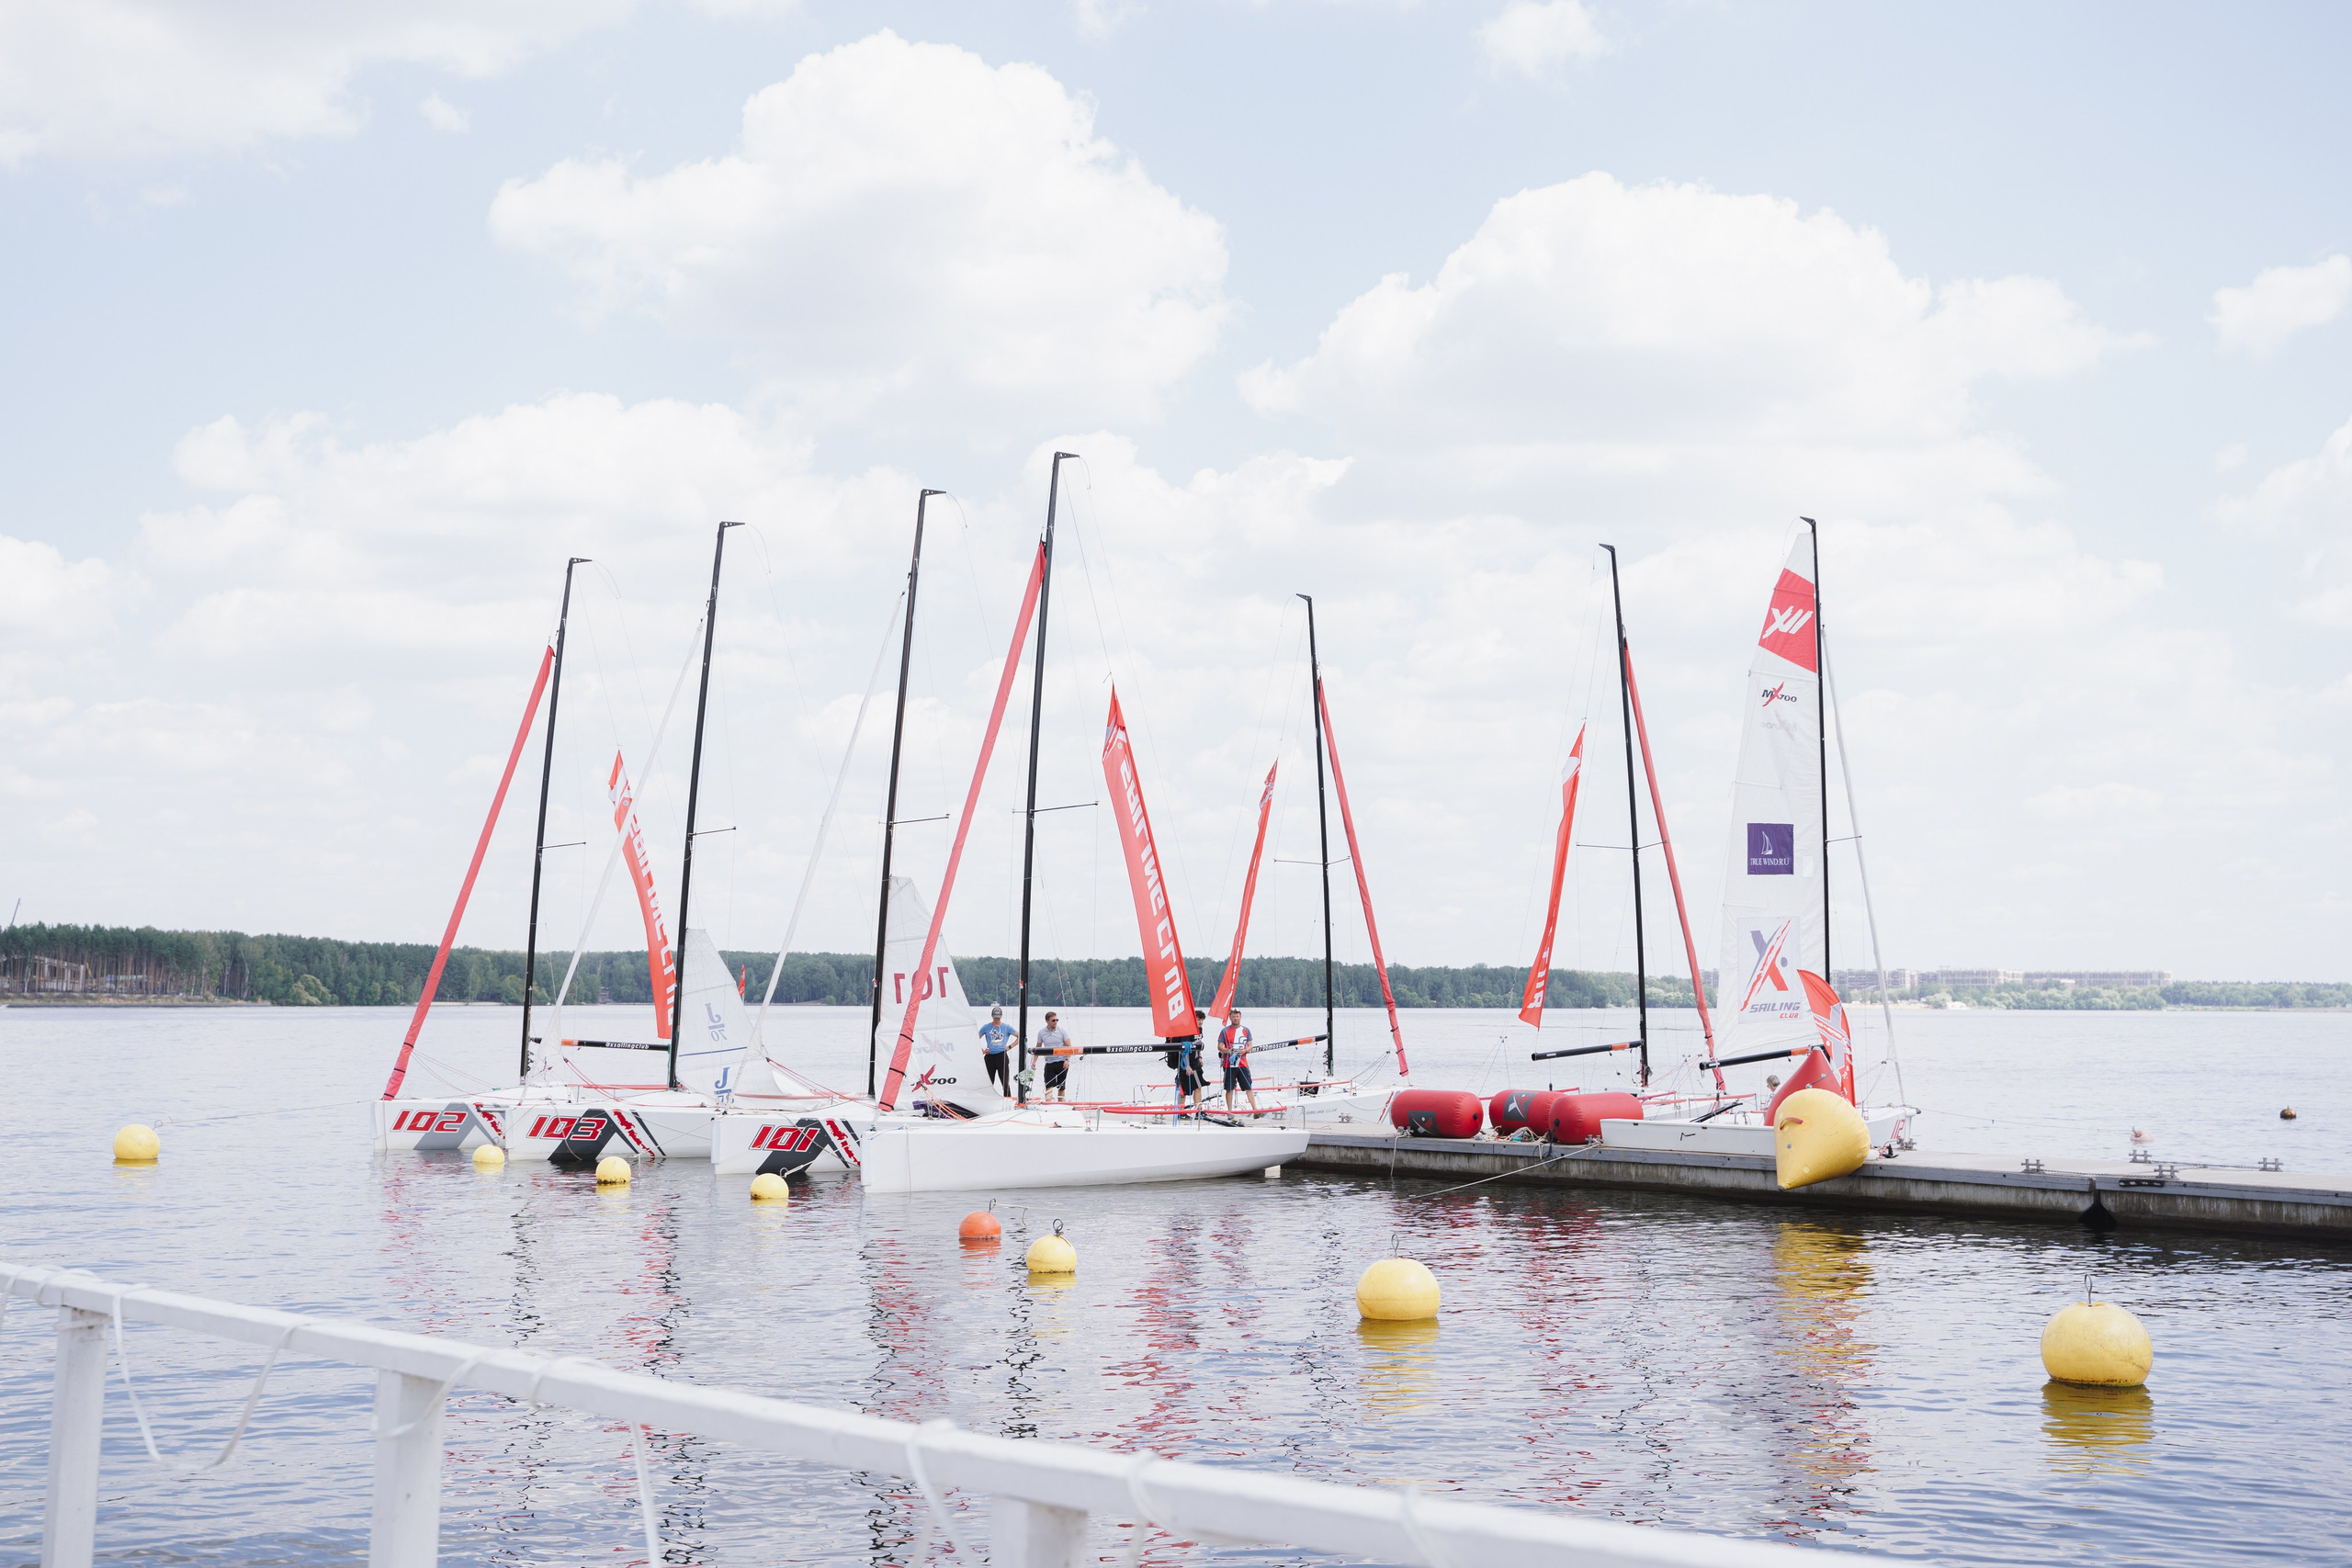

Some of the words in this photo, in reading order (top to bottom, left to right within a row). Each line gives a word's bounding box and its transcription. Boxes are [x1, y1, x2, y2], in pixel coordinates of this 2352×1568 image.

[1761, 682, 1797, 707] MX700
[1749, 1002, 1801, 1013] SAILING
[910, 1065, 956, 1092] X700
[390, 1109, 469, 1133] 102
[526, 1114, 608, 1141] 103
[749, 1124, 820, 1152] 101
